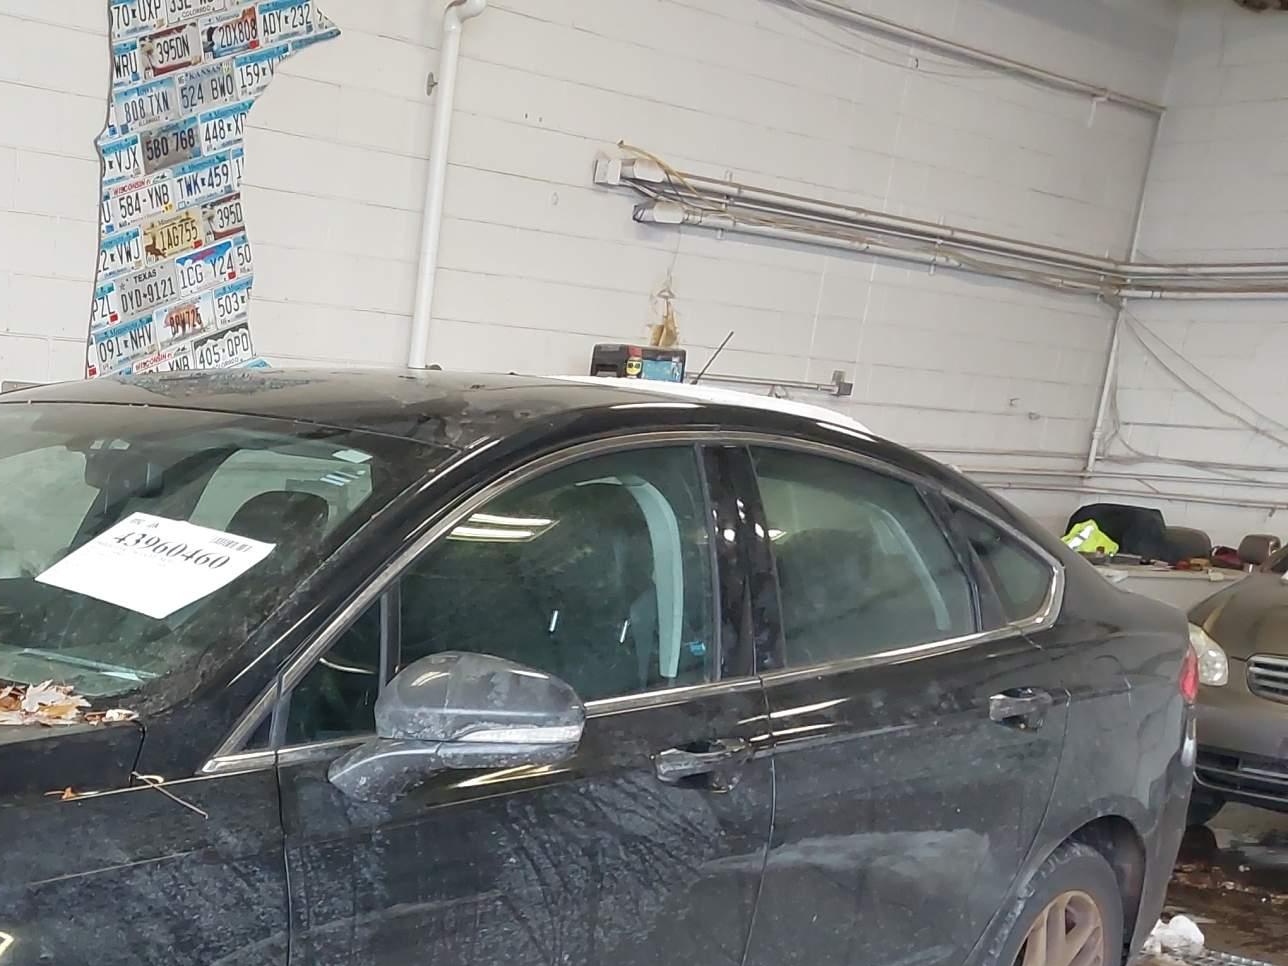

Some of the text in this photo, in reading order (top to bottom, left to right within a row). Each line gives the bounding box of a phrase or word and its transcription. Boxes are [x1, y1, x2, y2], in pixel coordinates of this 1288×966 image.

[262, 3, 311, 37] ADY 232
[156, 34, 190, 64] 395DN
[189, 64, 221, 80] KANSAS
[239, 62, 260, 88] 159
[124, 97, 146, 123] 808
[147, 89, 170, 117] TXN
[181, 83, 205, 109] 524
[172, 128, 195, 152] 768
[205, 118, 226, 143] 448
[115, 145, 140, 172] VJX
[177, 172, 202, 200] TWK
[207, 163, 229, 188] 459
[133, 269, 156, 284] TEXAS
[217, 291, 240, 318] 503
[99, 336, 123, 363] 091
[129, 323, 153, 351] NHV
[199, 343, 221, 369] 405
[113, 531, 232, 570] 43960460
